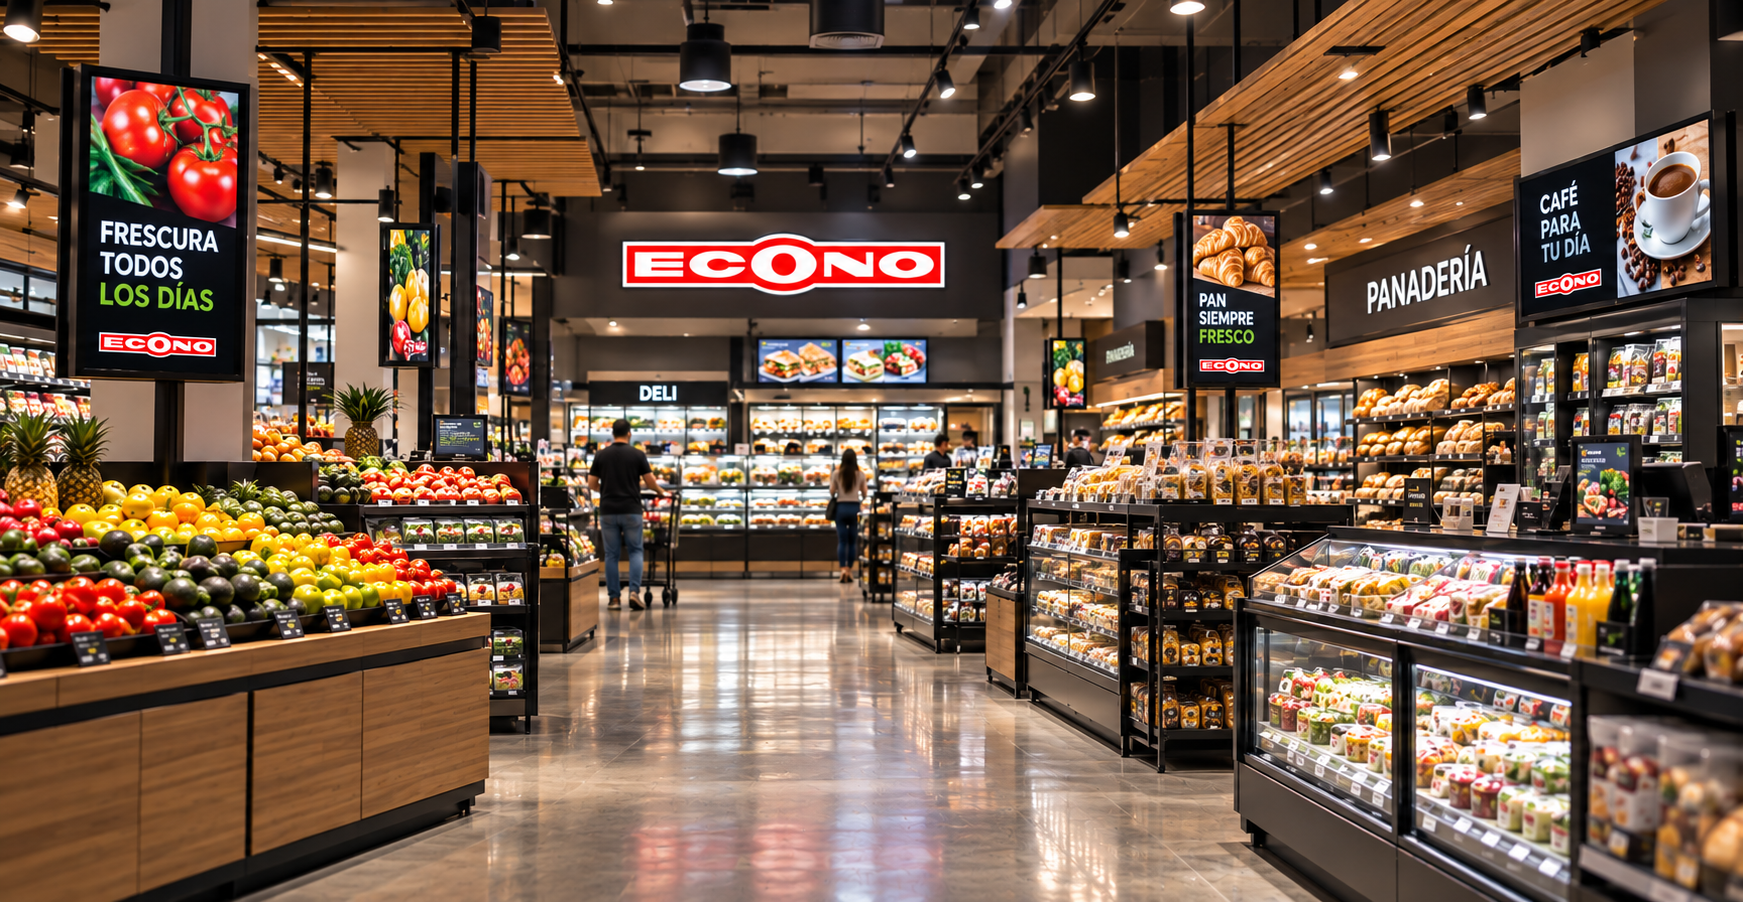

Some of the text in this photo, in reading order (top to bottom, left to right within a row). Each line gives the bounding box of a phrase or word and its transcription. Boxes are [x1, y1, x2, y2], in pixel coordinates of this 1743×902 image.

[1540, 180, 1579, 214] CAFÉ
[100, 220, 219, 253] FRESCURA
[1541, 210, 1581, 240] PARA
[1541, 231, 1591, 263] TU DÍA
[100, 251, 183, 280] TODOS
[633, 243, 936, 285] ECONO
[1367, 244, 1488, 315] PANADERÍA
[1537, 273, 1600, 295] ECONO
[99, 281, 214, 312] LOS DÍAS
[1199, 292, 1227, 308] PAN
[1199, 310, 1254, 326] SIEMPRE
[103, 336, 214, 355] ECONO
[1199, 328, 1255, 345] FRESCO
[1201, 360, 1263, 371] ECONO
[638, 385, 678, 402] DELI
